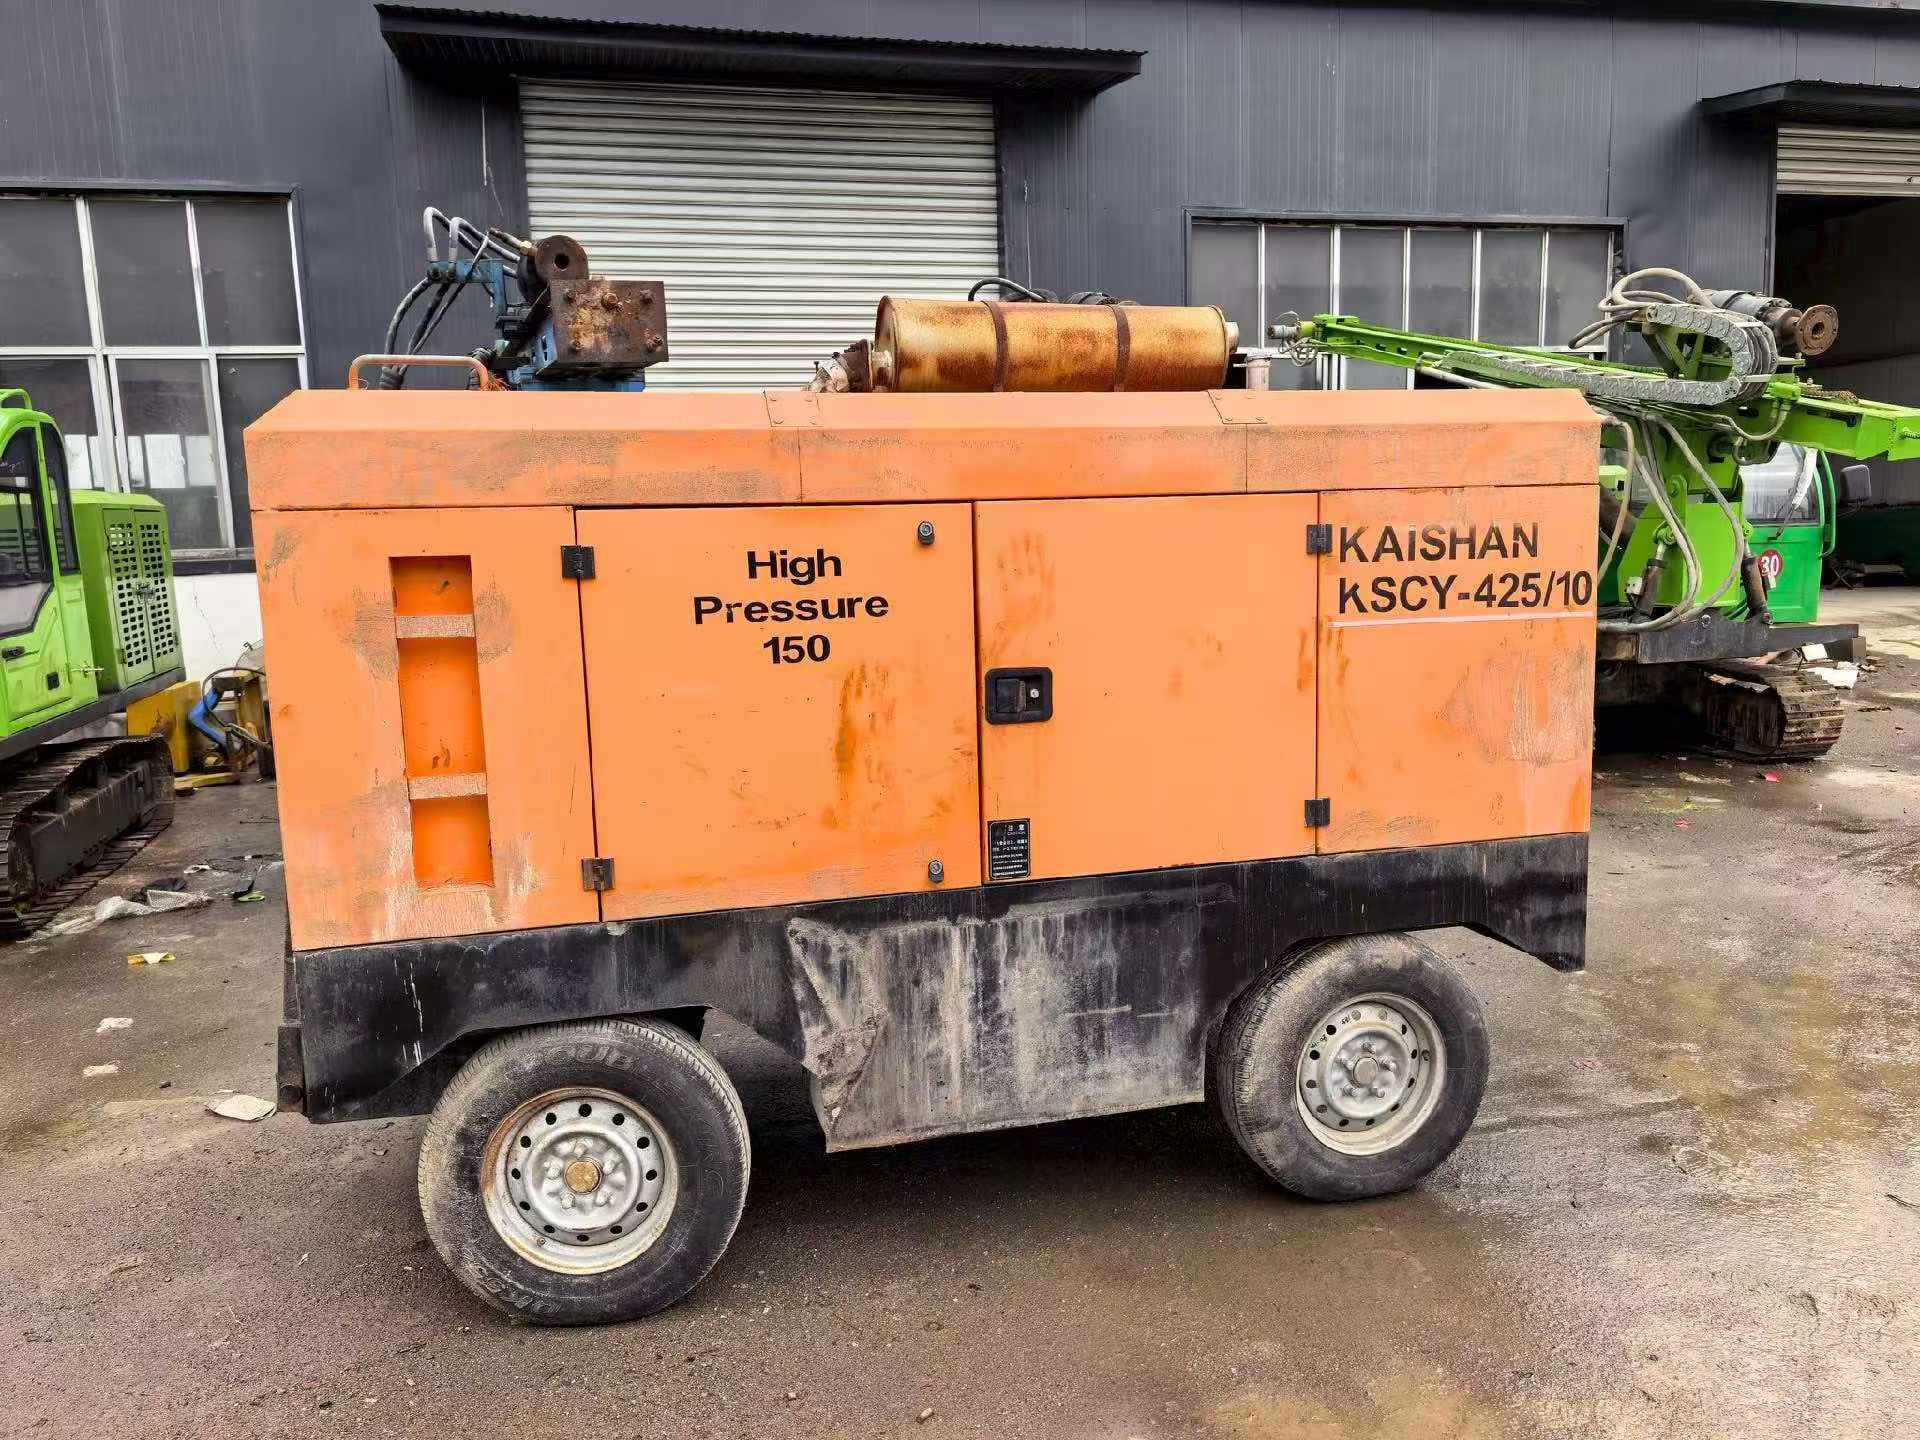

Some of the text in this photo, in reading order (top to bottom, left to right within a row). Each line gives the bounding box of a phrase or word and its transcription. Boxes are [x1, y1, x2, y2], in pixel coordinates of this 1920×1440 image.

[1339, 522, 1539, 562] KAISHAN
[747, 548, 842, 585] High
[1761, 555, 1779, 576] 30
[1339, 570, 1593, 614] KSCY-425/10
[694, 596, 889, 624] Pressure
[763, 634, 831, 664] 150
